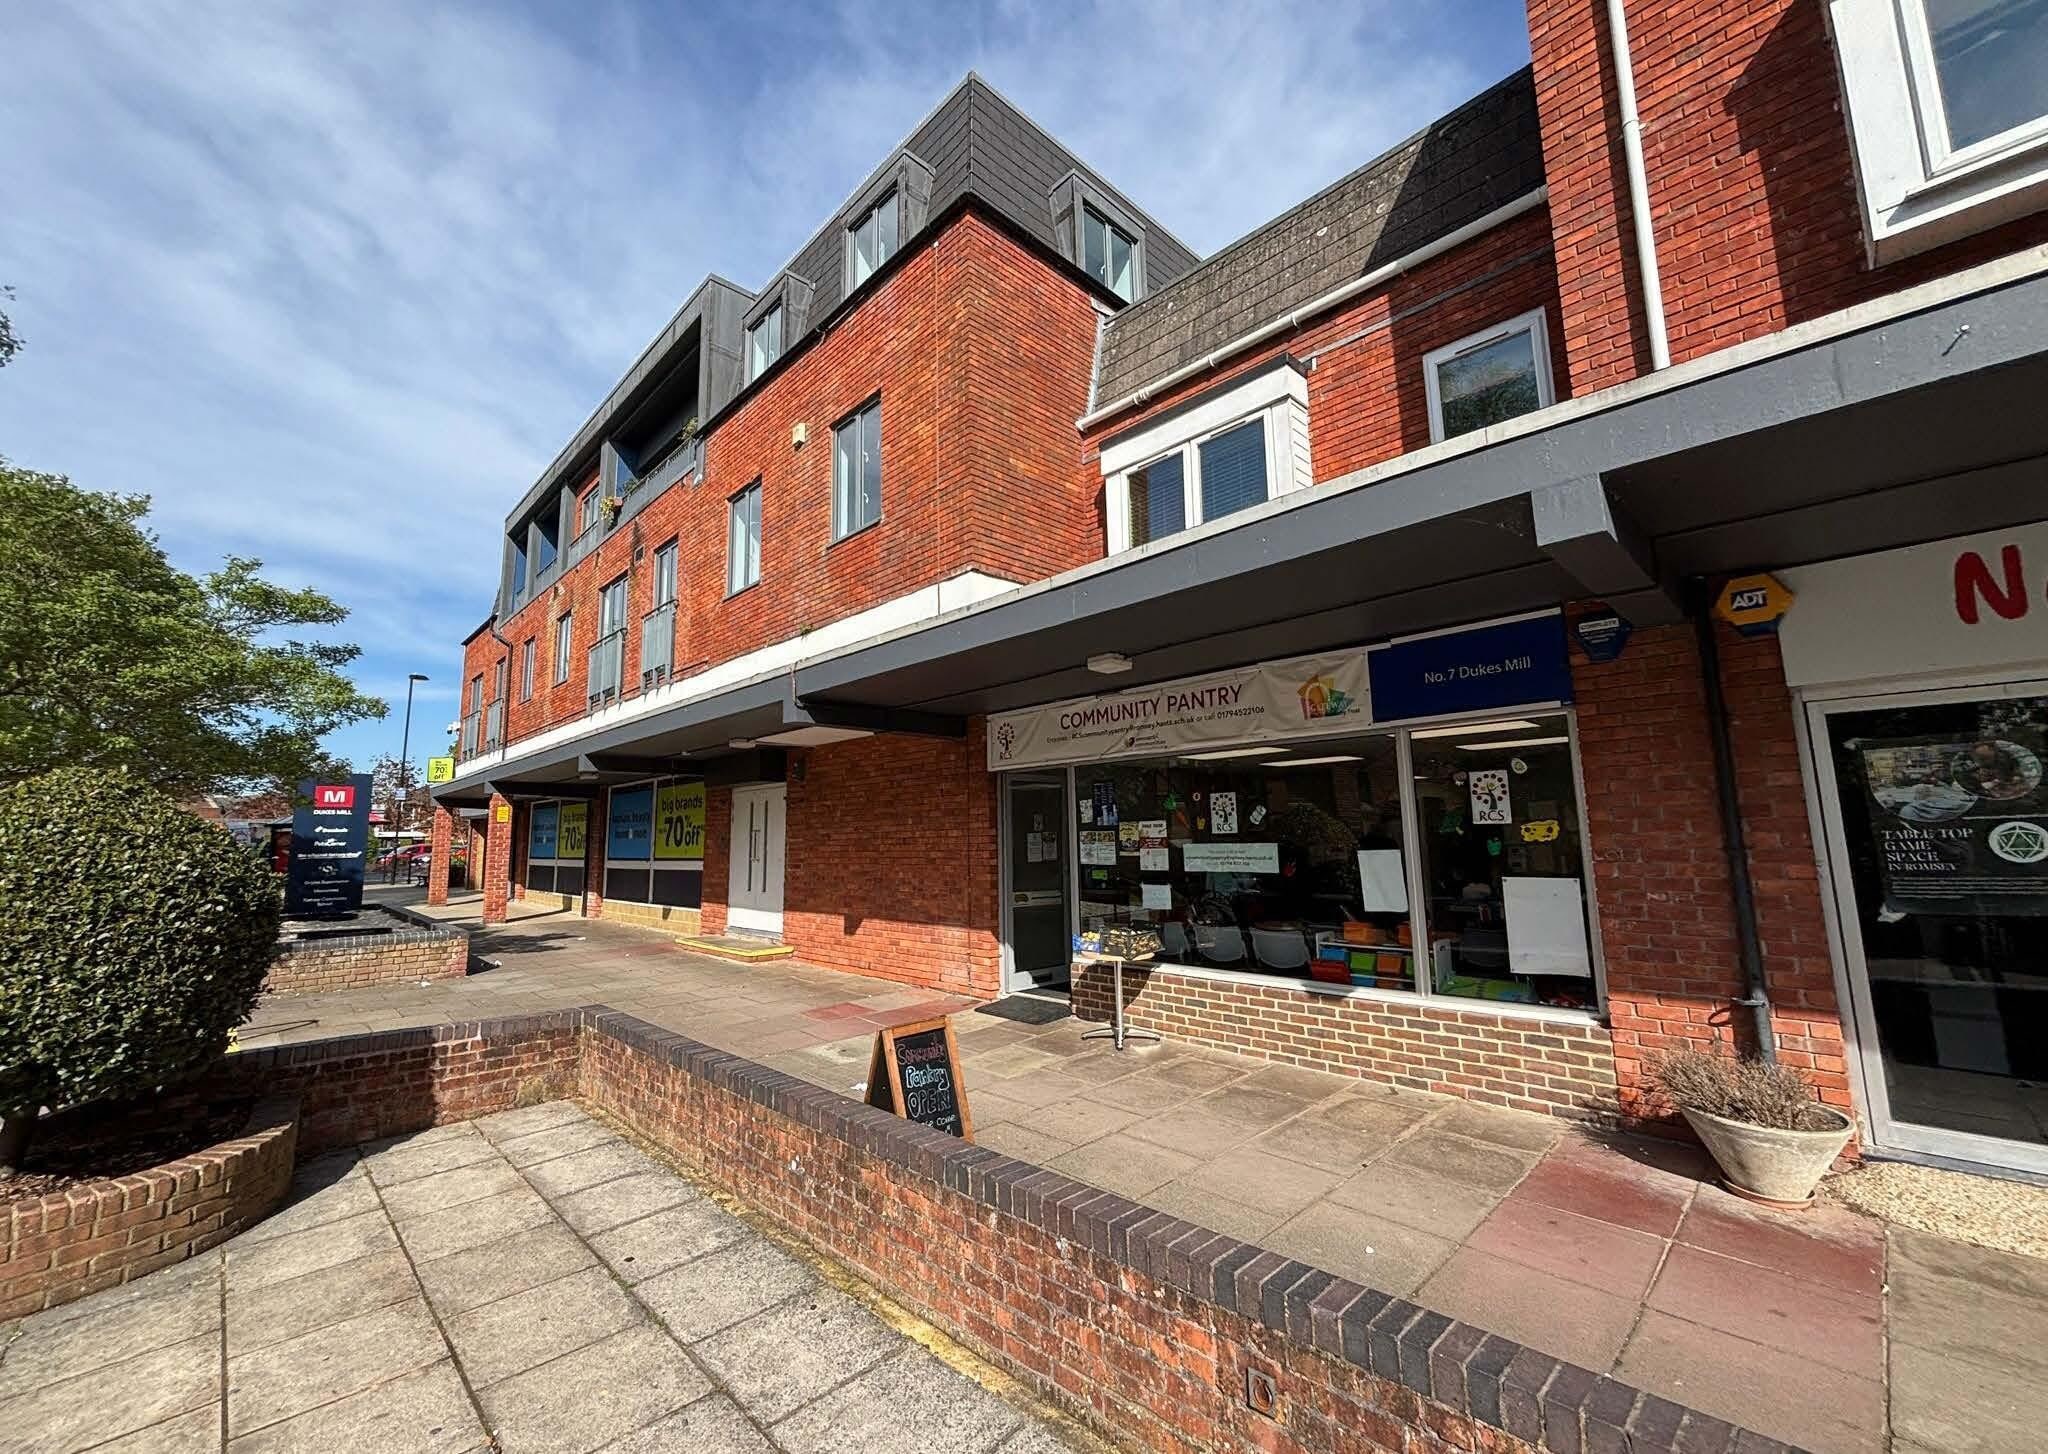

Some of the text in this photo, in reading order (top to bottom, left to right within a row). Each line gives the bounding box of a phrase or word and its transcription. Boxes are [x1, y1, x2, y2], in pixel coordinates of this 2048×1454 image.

[1954, 544, 2048, 625] N
[1732, 589, 1767, 610] ADT
[1459, 663, 1503, 680] Dukes
[1504, 655, 1532, 672] Mill
[1060, 684, 1243, 730] COMMUNITY PANTRY
[999, 750, 1013, 761] RCS
[323, 790, 346, 804] M
[661, 794, 704, 815] big brands
[1479, 809, 1505, 822] RCS
[1216, 822, 1233, 832] RCS
[1880, 826, 1975, 841] TABLE TOP
[1883, 840, 1932, 851] GAME
[1886, 850, 1940, 863] SPACE
[1903, 861, 1959, 872] ROMSEY
[905, 1063, 950, 1091] Pantry
[907, 1088, 952, 1118] OPEN
